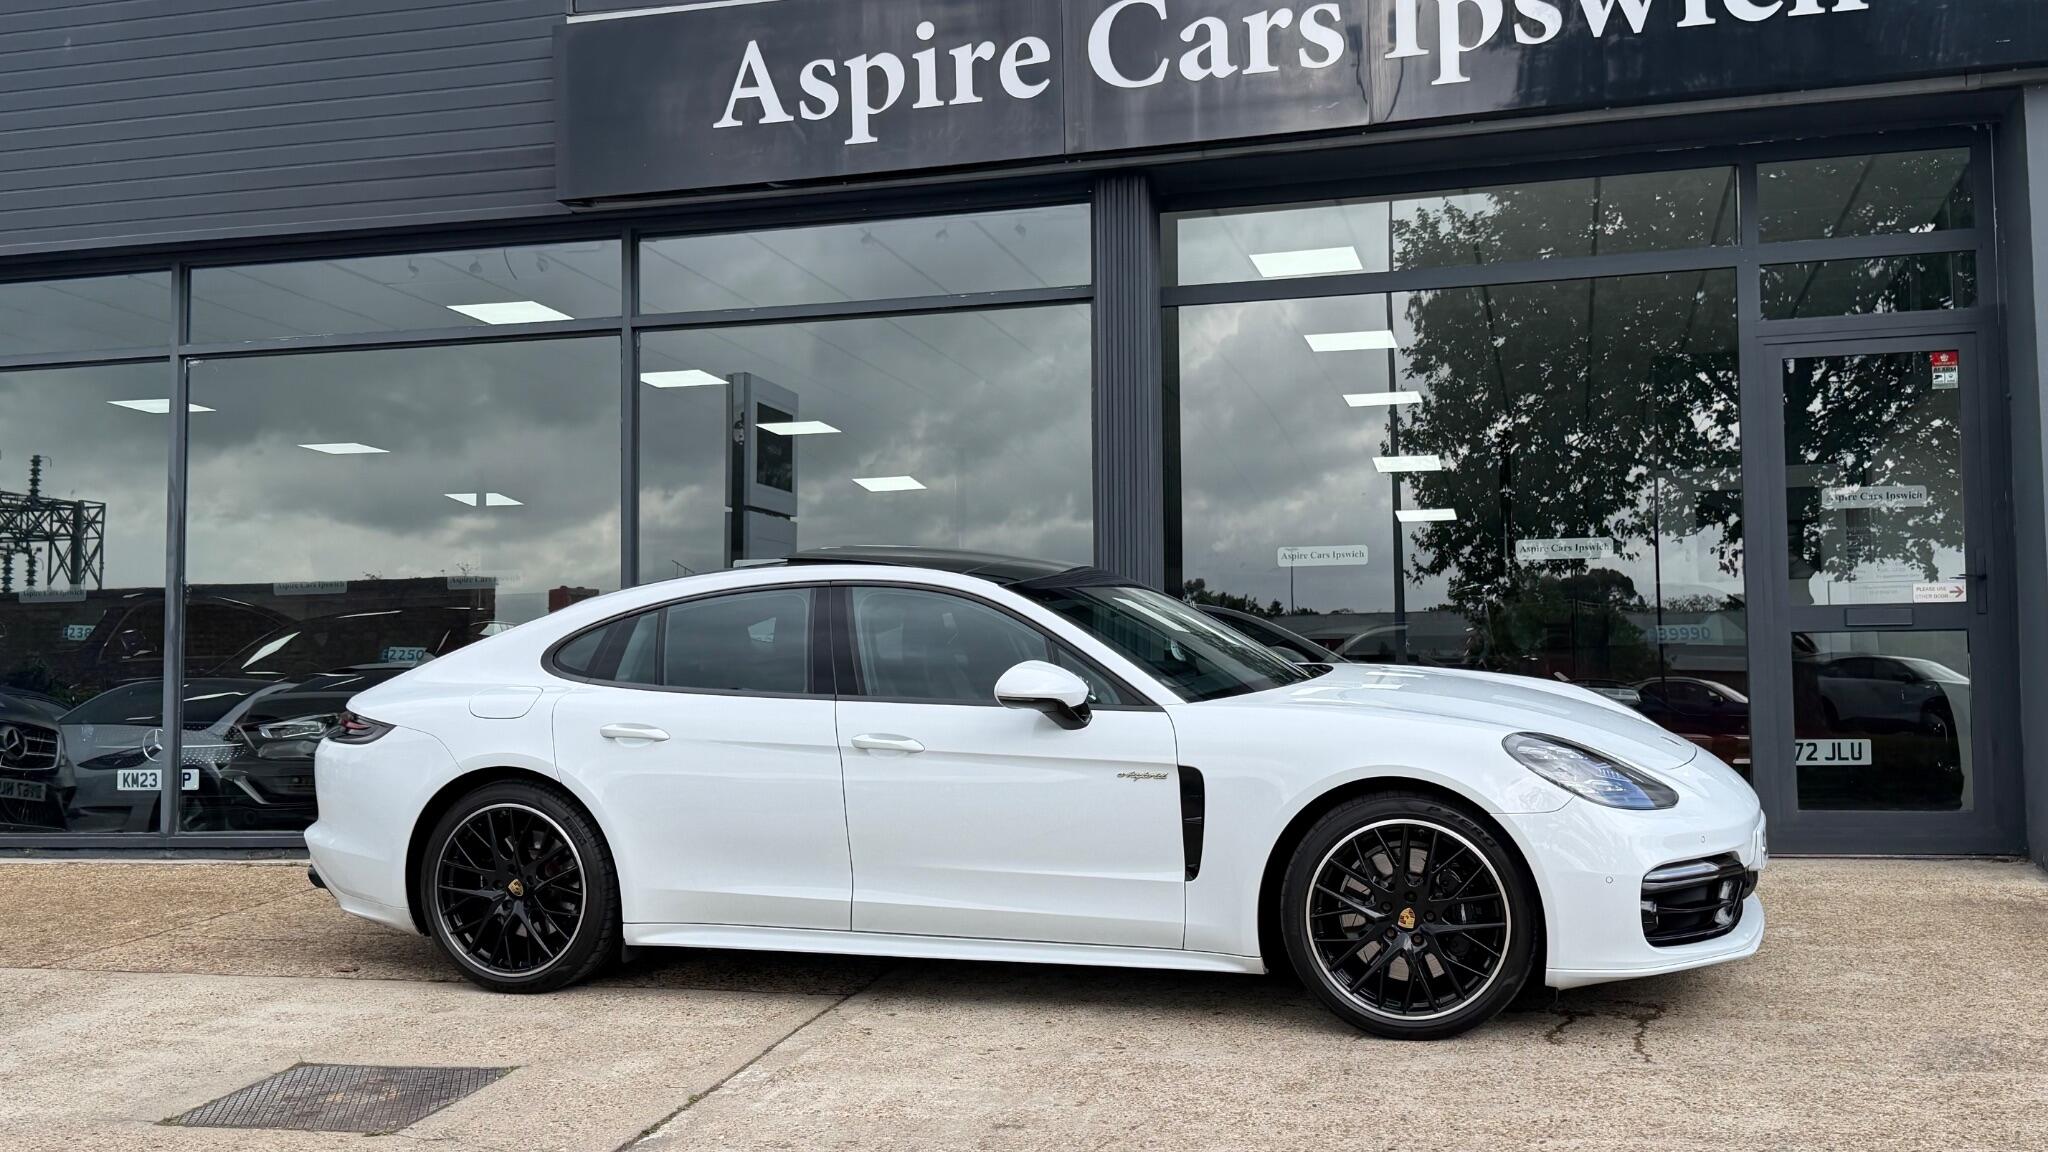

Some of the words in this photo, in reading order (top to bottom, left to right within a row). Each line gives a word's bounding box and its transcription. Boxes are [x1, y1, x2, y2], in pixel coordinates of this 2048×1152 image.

[713, 21, 1051, 145] Aspire
[1087, 0, 1345, 88] Cars
[1384, 0, 1870, 86] Ipsw
[1860, 491, 1883, 501] Cars
[1551, 543, 1572, 552] Cars
[1280, 551, 1309, 562] Aspire
[1310, 550, 1331, 559] Cars
[1332, 549, 1365, 561] Ipswich
[1825, 742, 1862, 761] JLU
[122, 772, 158, 788] KM23
